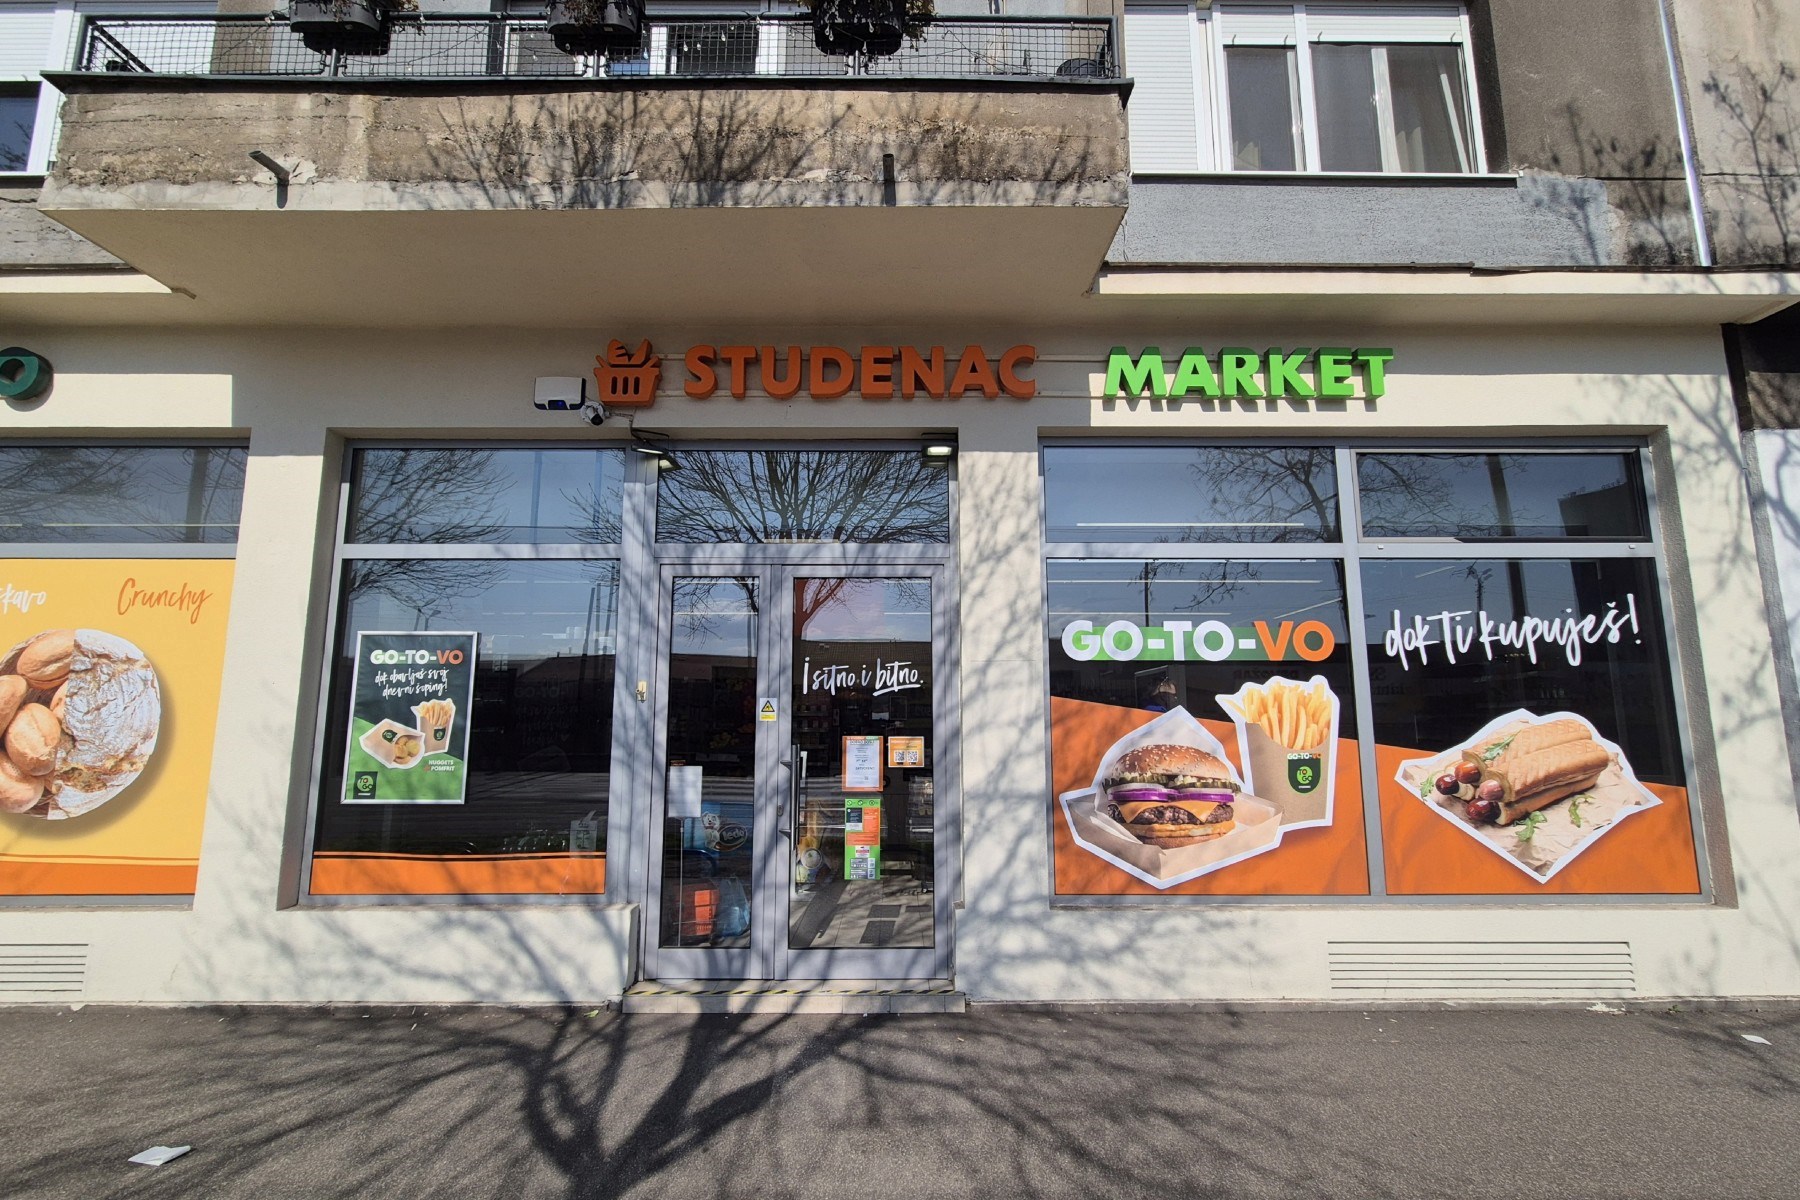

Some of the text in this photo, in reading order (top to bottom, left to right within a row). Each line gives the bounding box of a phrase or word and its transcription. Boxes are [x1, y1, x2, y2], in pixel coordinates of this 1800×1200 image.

[684, 345, 1036, 400] STUDENAC
[1103, 347, 1394, 401] MARKET
[117, 577, 213, 625] Crunchy
[1061, 619, 1335, 662] GO-TO-VO
[1385, 593, 1642, 671] dok Ti kupuješ!
[370, 649, 464, 665] GO-TO-VO
[375, 670, 389, 687] dok
[427, 666, 449, 683] svoj
[812, 664, 856, 696] sitno
[872, 657, 924, 697] bitno.
